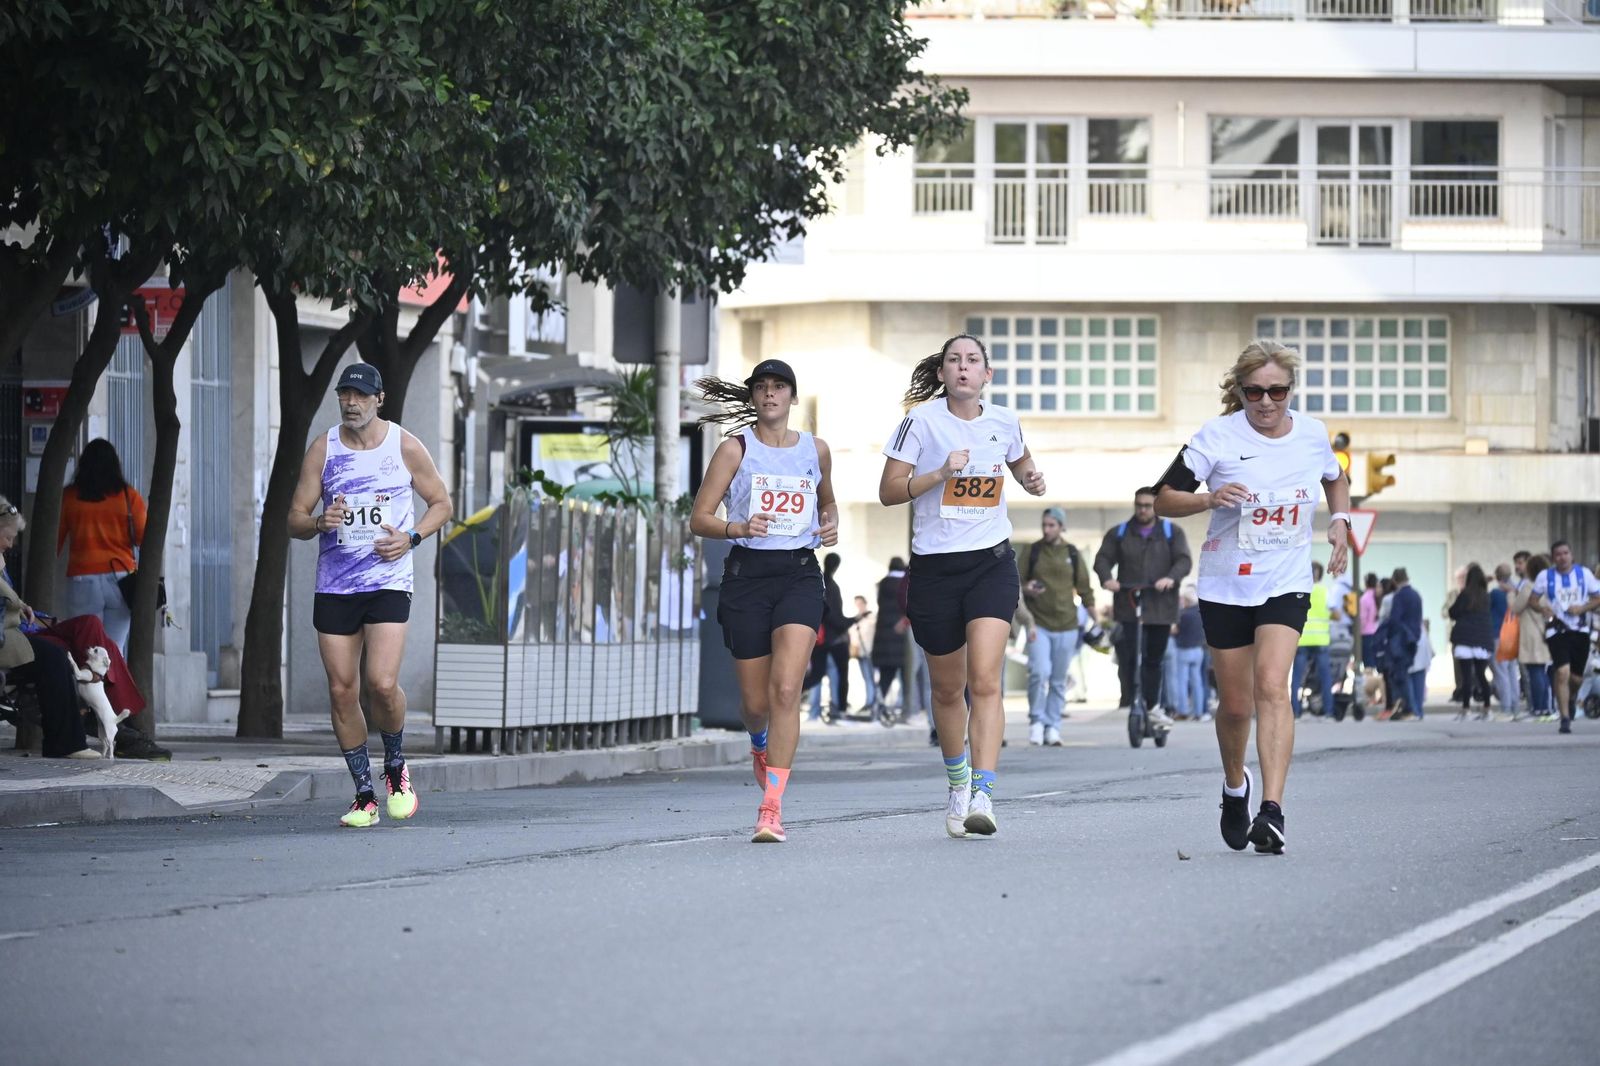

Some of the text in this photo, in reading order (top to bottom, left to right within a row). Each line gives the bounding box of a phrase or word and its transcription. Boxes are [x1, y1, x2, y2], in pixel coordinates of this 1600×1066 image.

[953, 477, 997, 498] 582
[761, 490, 805, 514] 929
[957, 506, 985, 515] Huelva
[343, 507, 382, 526] 916
[1252, 504, 1299, 526] 941
[349, 533, 374, 541] Huelva
[1258, 536, 1289, 545] Huelva
